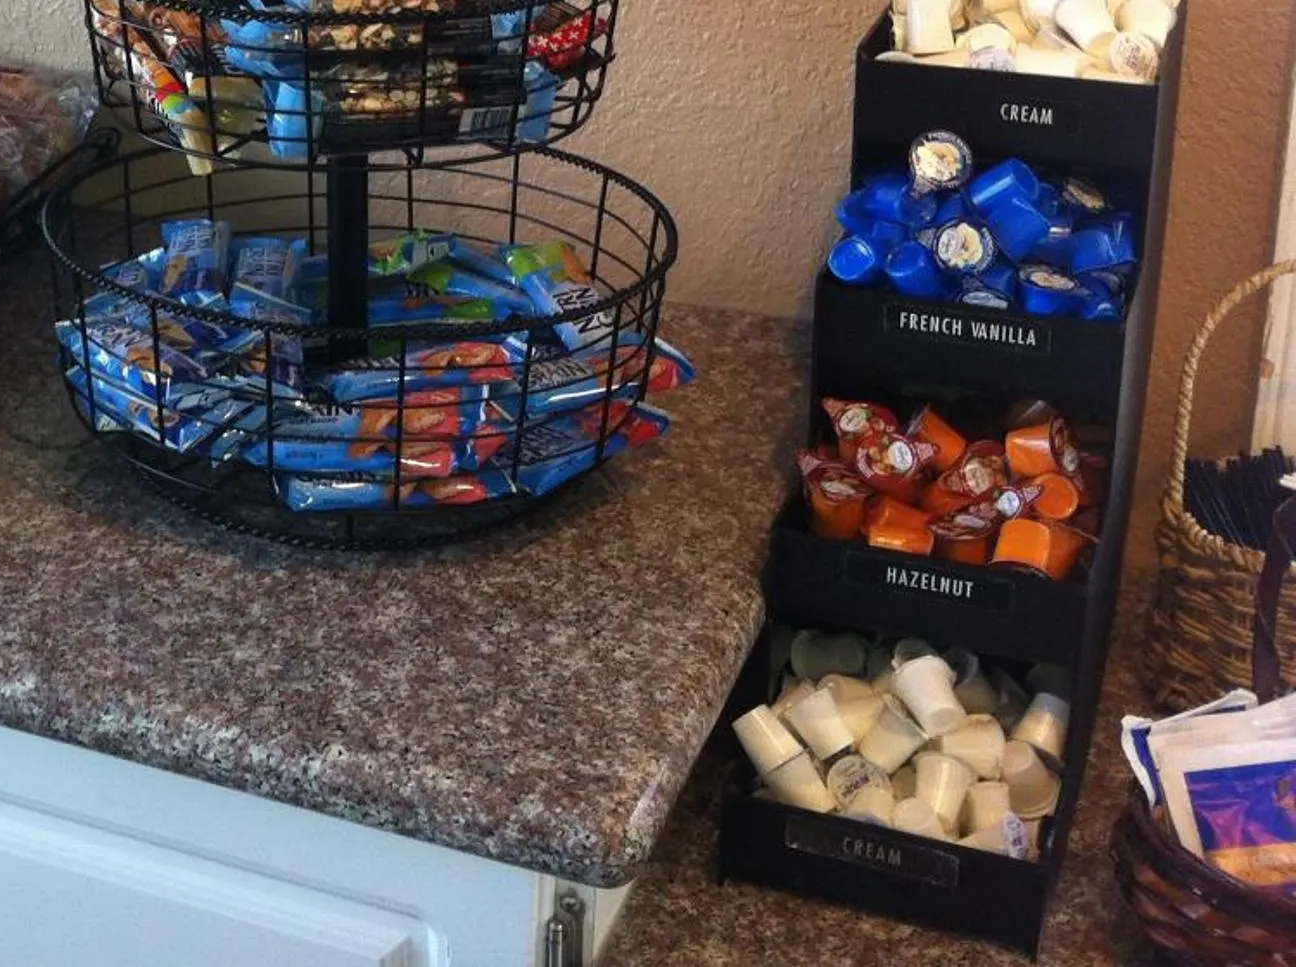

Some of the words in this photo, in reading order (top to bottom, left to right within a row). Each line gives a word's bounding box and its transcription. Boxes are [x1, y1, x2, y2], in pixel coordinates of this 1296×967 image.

[1000, 102, 1053, 125] CREAM
[899, 311, 962, 336] FRENCH
[971, 321, 1036, 346] VANILLA
[886, 566, 974, 598] HAZELNUT
[842, 836, 902, 867] CREAM
